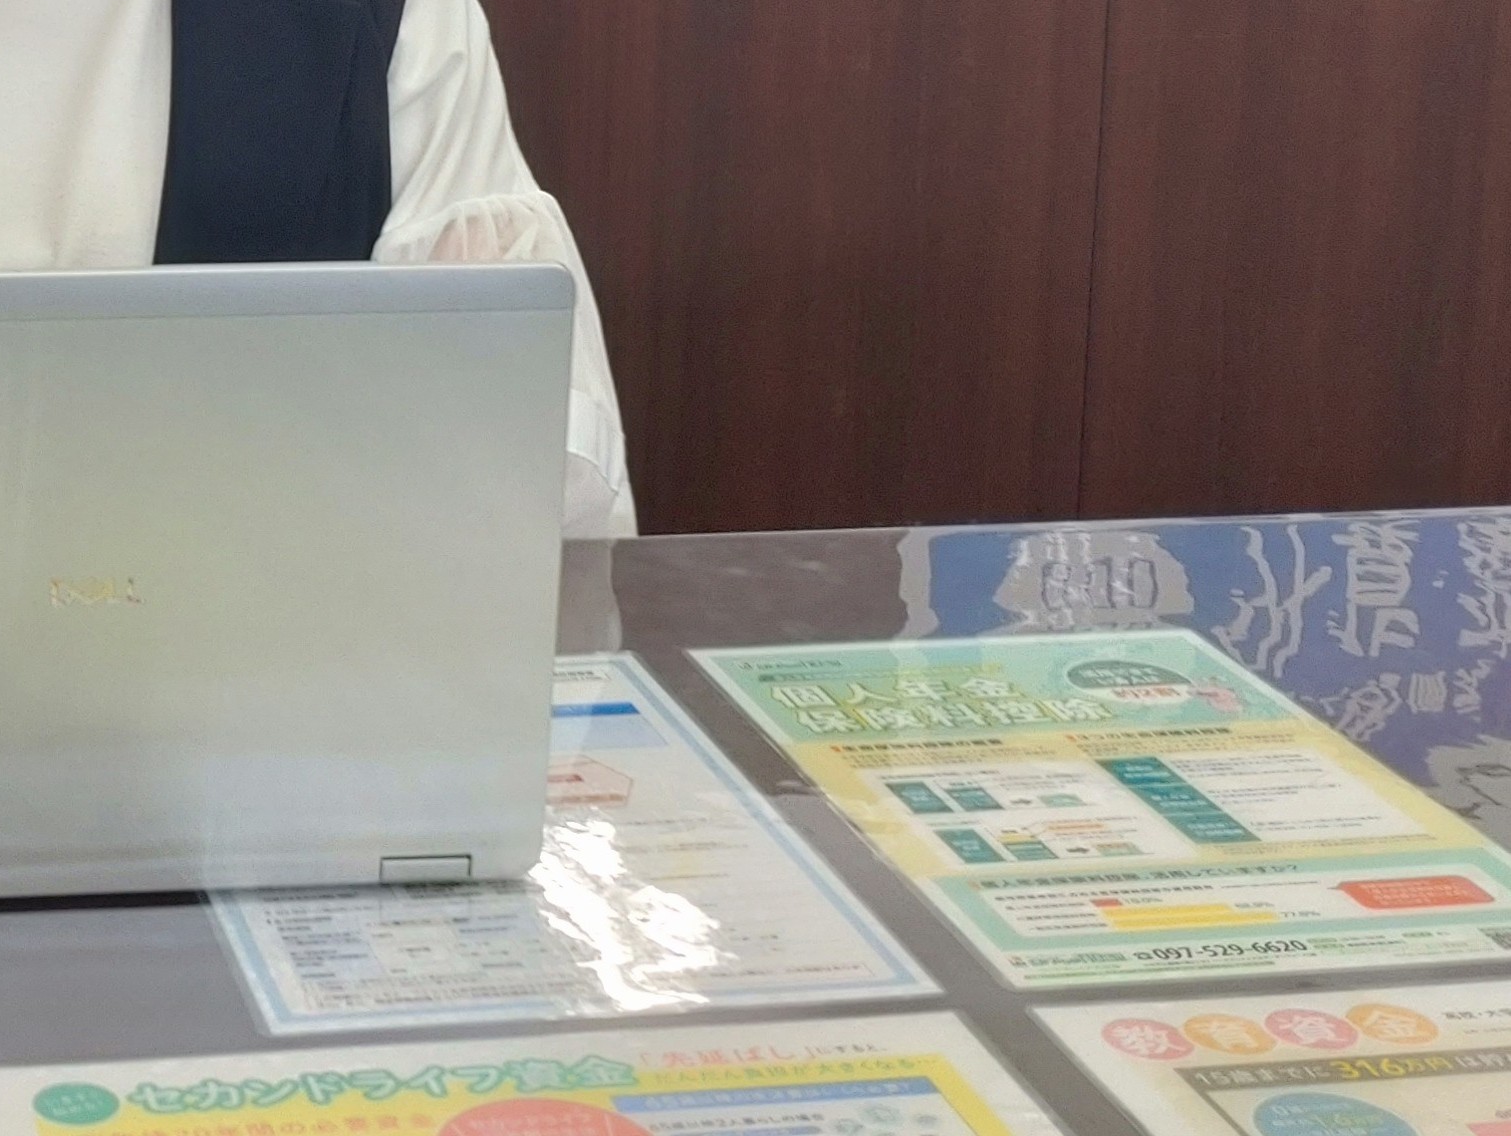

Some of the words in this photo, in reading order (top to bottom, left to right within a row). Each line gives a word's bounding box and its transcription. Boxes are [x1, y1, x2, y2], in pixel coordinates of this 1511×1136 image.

[770, 678, 1026, 709] 個人年金
[796, 698, 1113, 733] 保険料控除
[1151, 939, 1308, 961] 097-529-6620
[1111, 1009, 1419, 1056] 教育資金
[126, 1054, 638, 1114] セカンドライフ資金
